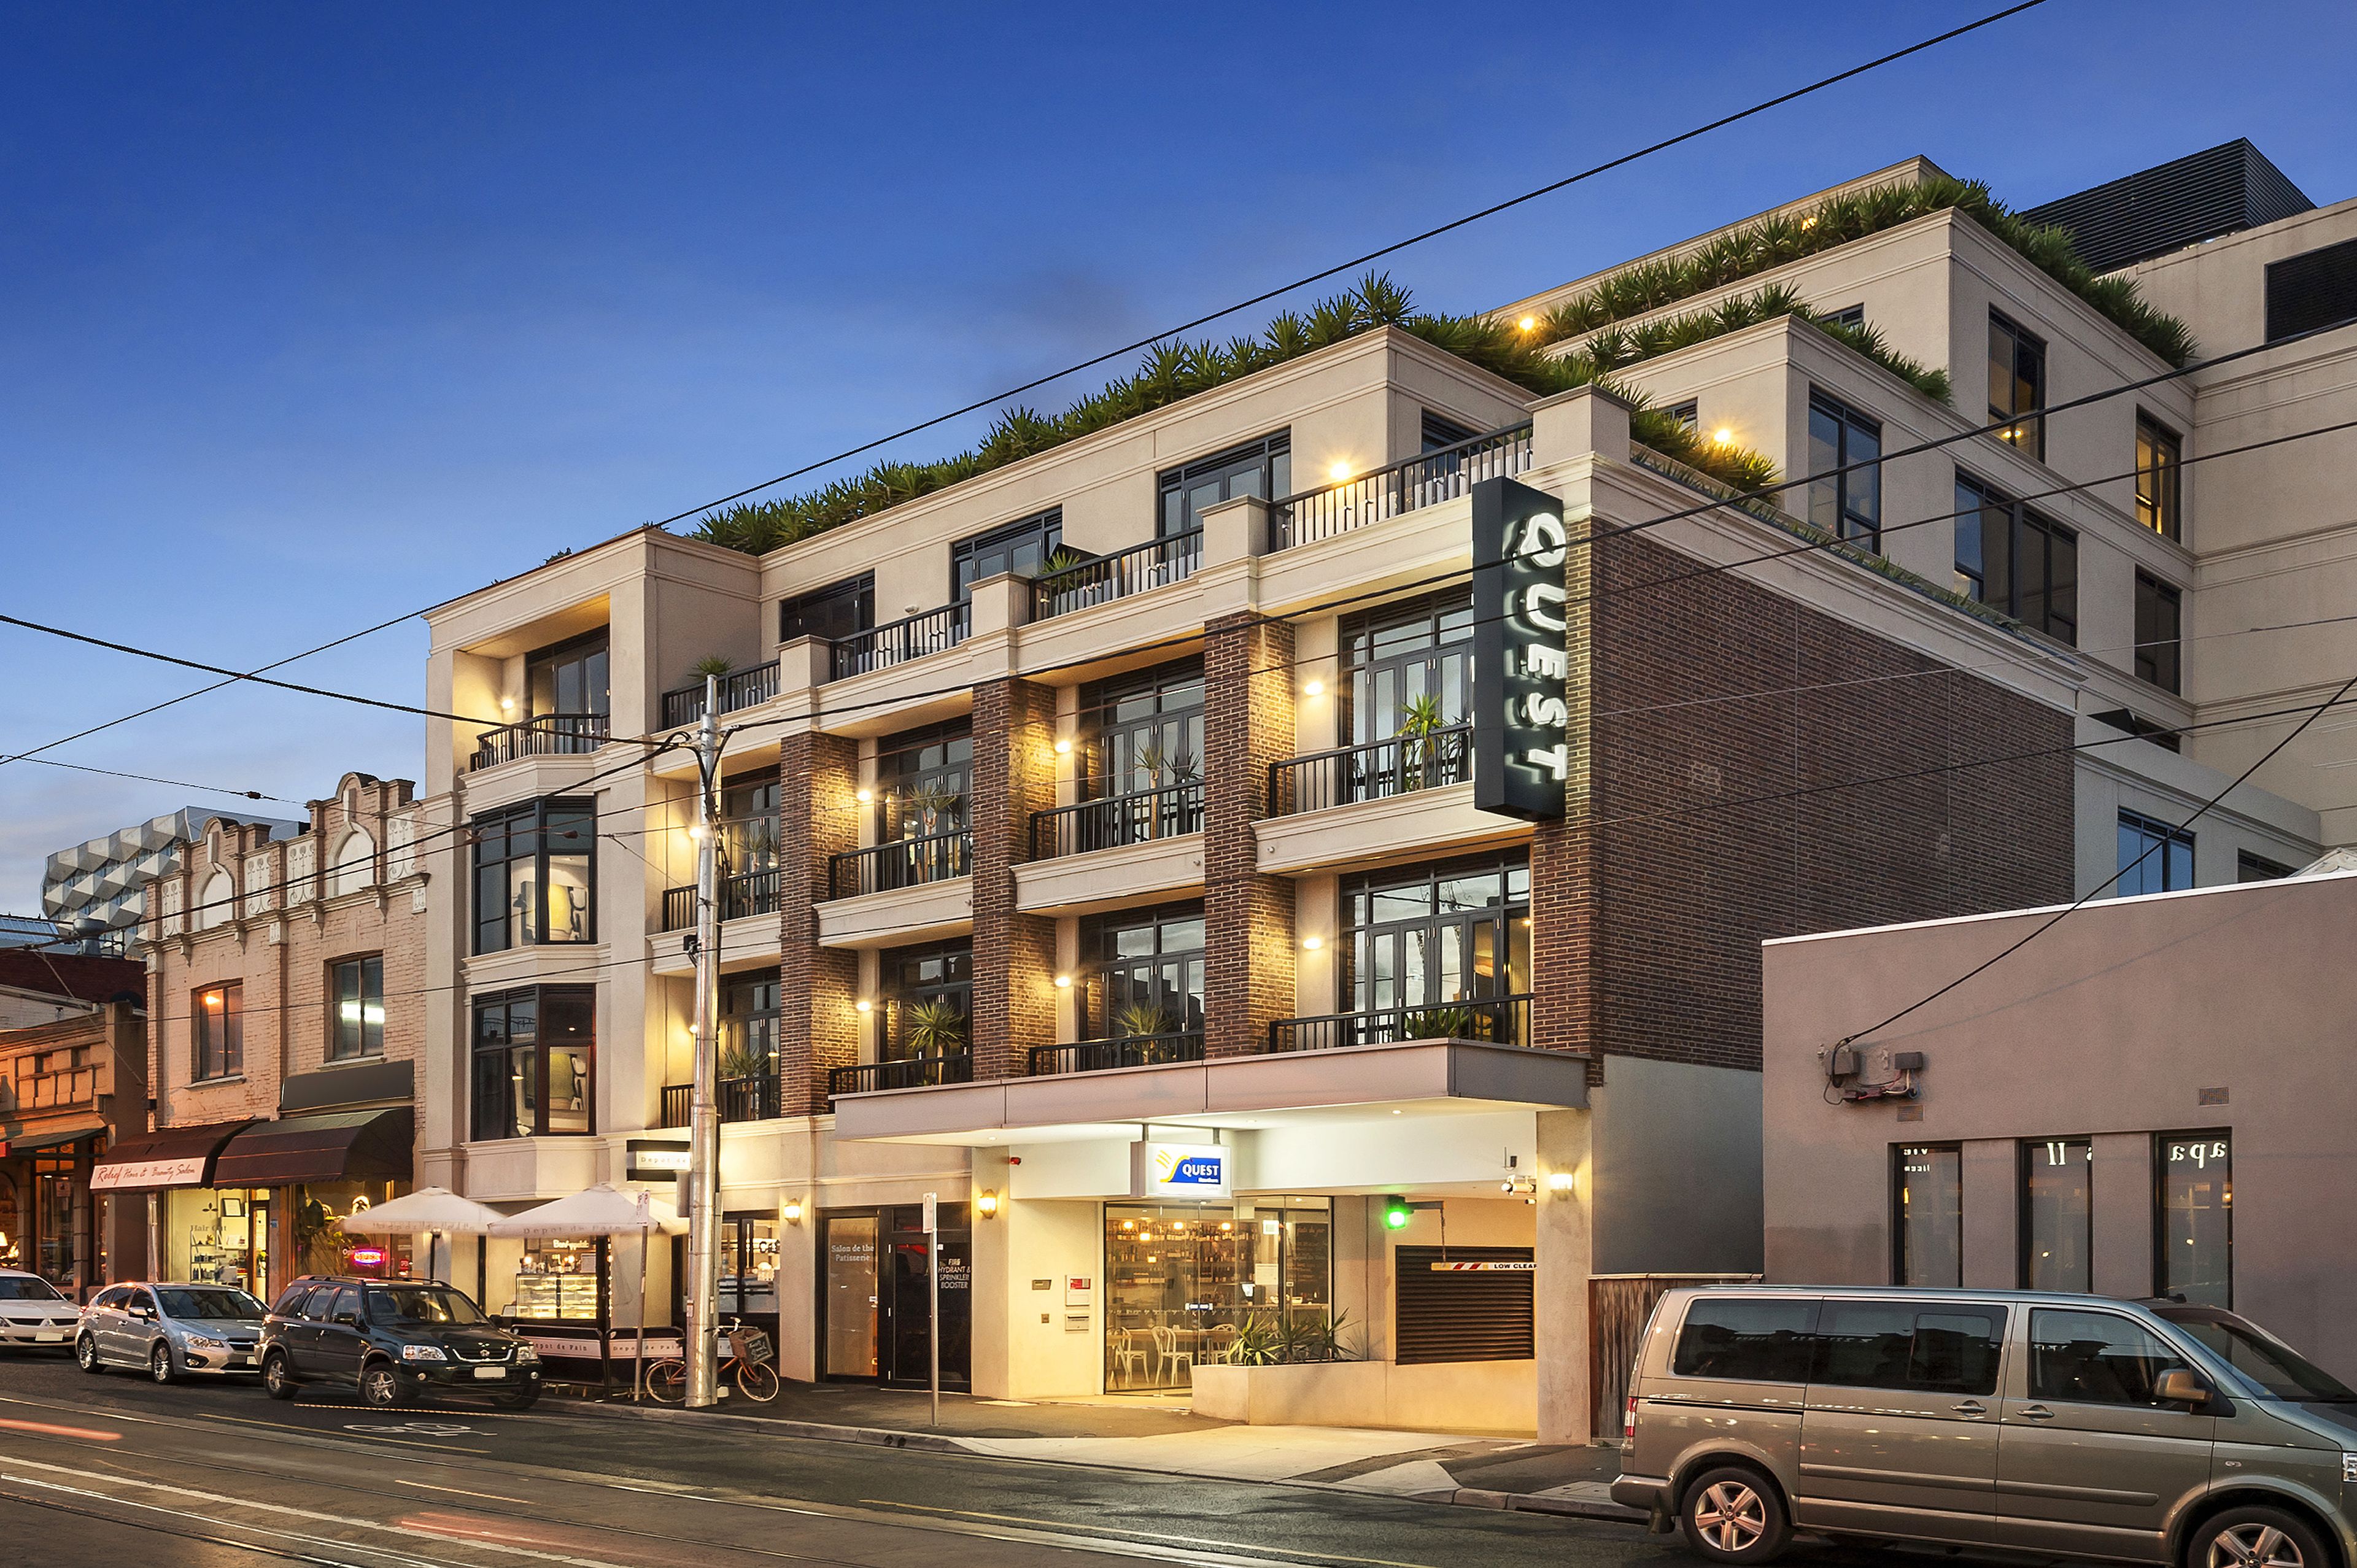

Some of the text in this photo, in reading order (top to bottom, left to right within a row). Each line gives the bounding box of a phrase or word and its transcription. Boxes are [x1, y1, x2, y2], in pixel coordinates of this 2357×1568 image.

[1519, 512, 1568, 781] QUEST
[97, 1167, 123, 1186] Relief
[176, 1164, 196, 1176] Salon
[1182, 1163, 1219, 1178] QUEST
